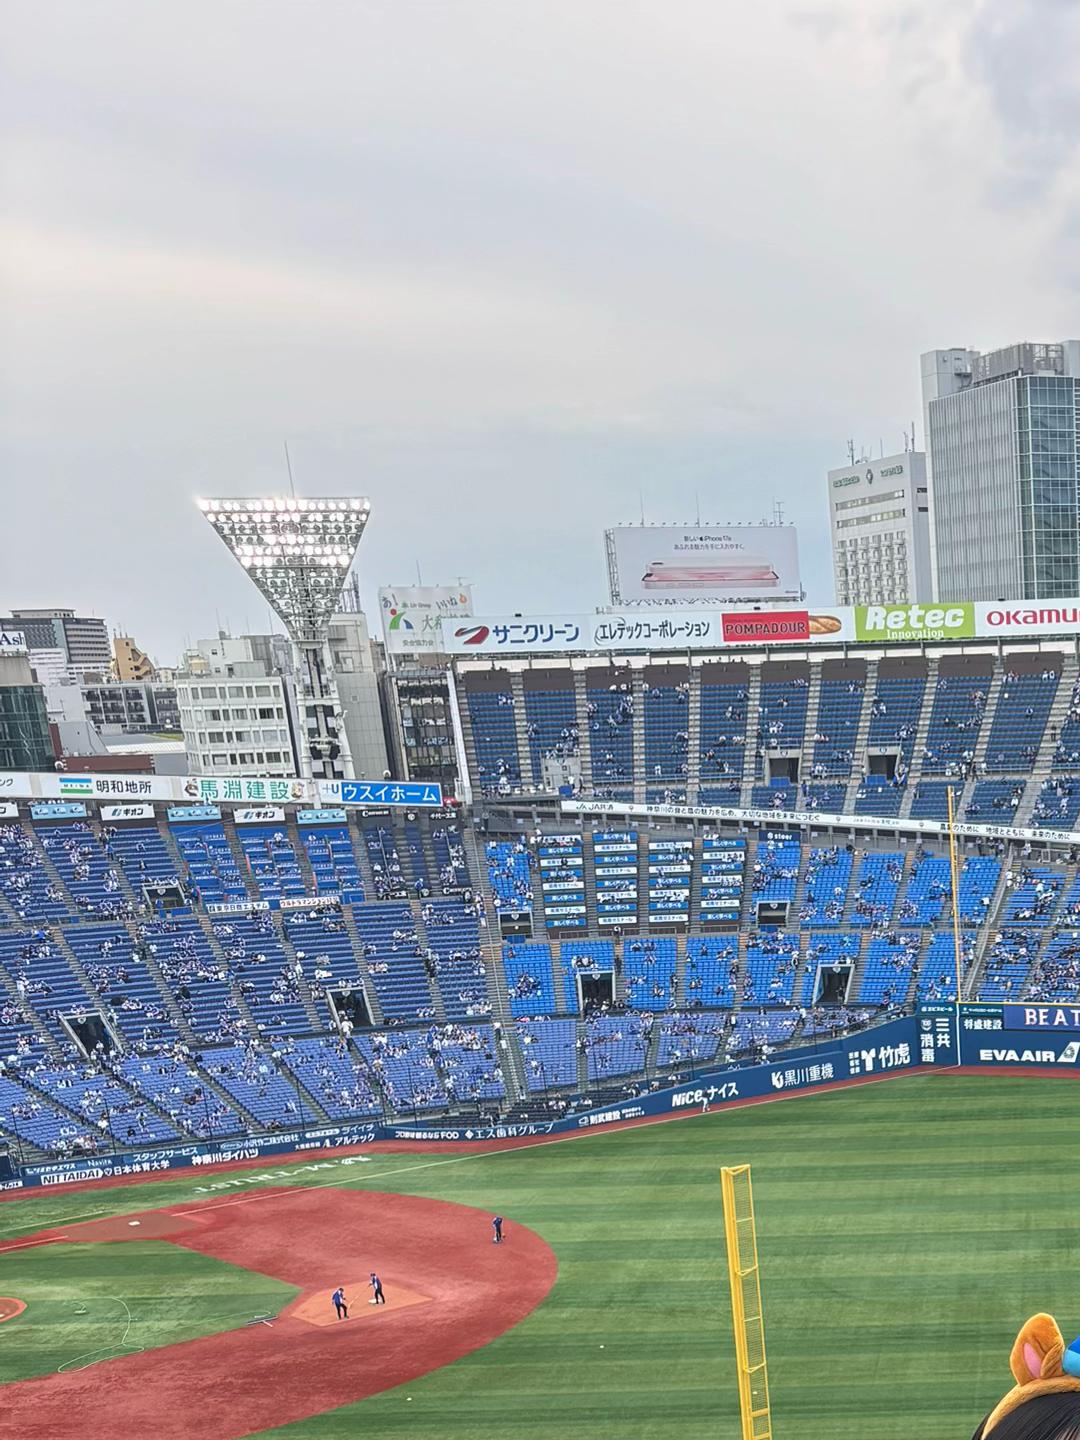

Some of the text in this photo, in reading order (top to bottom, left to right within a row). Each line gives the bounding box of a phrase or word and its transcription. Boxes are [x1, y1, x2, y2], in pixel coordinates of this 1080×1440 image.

[865, 604, 965, 630] Retec
[492, 623, 580, 645] サニクリーン
[599, 619, 711, 641] エレテックコーポレーション
[725, 620, 807, 635] POMPADOUR
[886, 628, 945, 640] Innovation
[96, 779, 152, 794] 明和地所
[343, 783, 438, 802] ウスイホーム
[1024, 1009, 1049, 1026] BE
[1054, 1009, 1069, 1027] A
[879, 1043, 910, 1069] 竹虎
[980, 1049, 1055, 1062] EVA AIR
[784, 1062, 835, 1087] 黒川重機
[706, 1082, 739, 1101] ナイス
[335, 1133, 375, 1147] アルテック
[440, 1130, 459, 1140] FOD
[133, 1146, 199, 1161] スタッフサービス
[191, 1149, 259, 1165] 神奈川ダイハツ
[114, 1159, 170, 1176] 日本体育大学
[42, 1169, 101, 1185] NITTAIDAI
